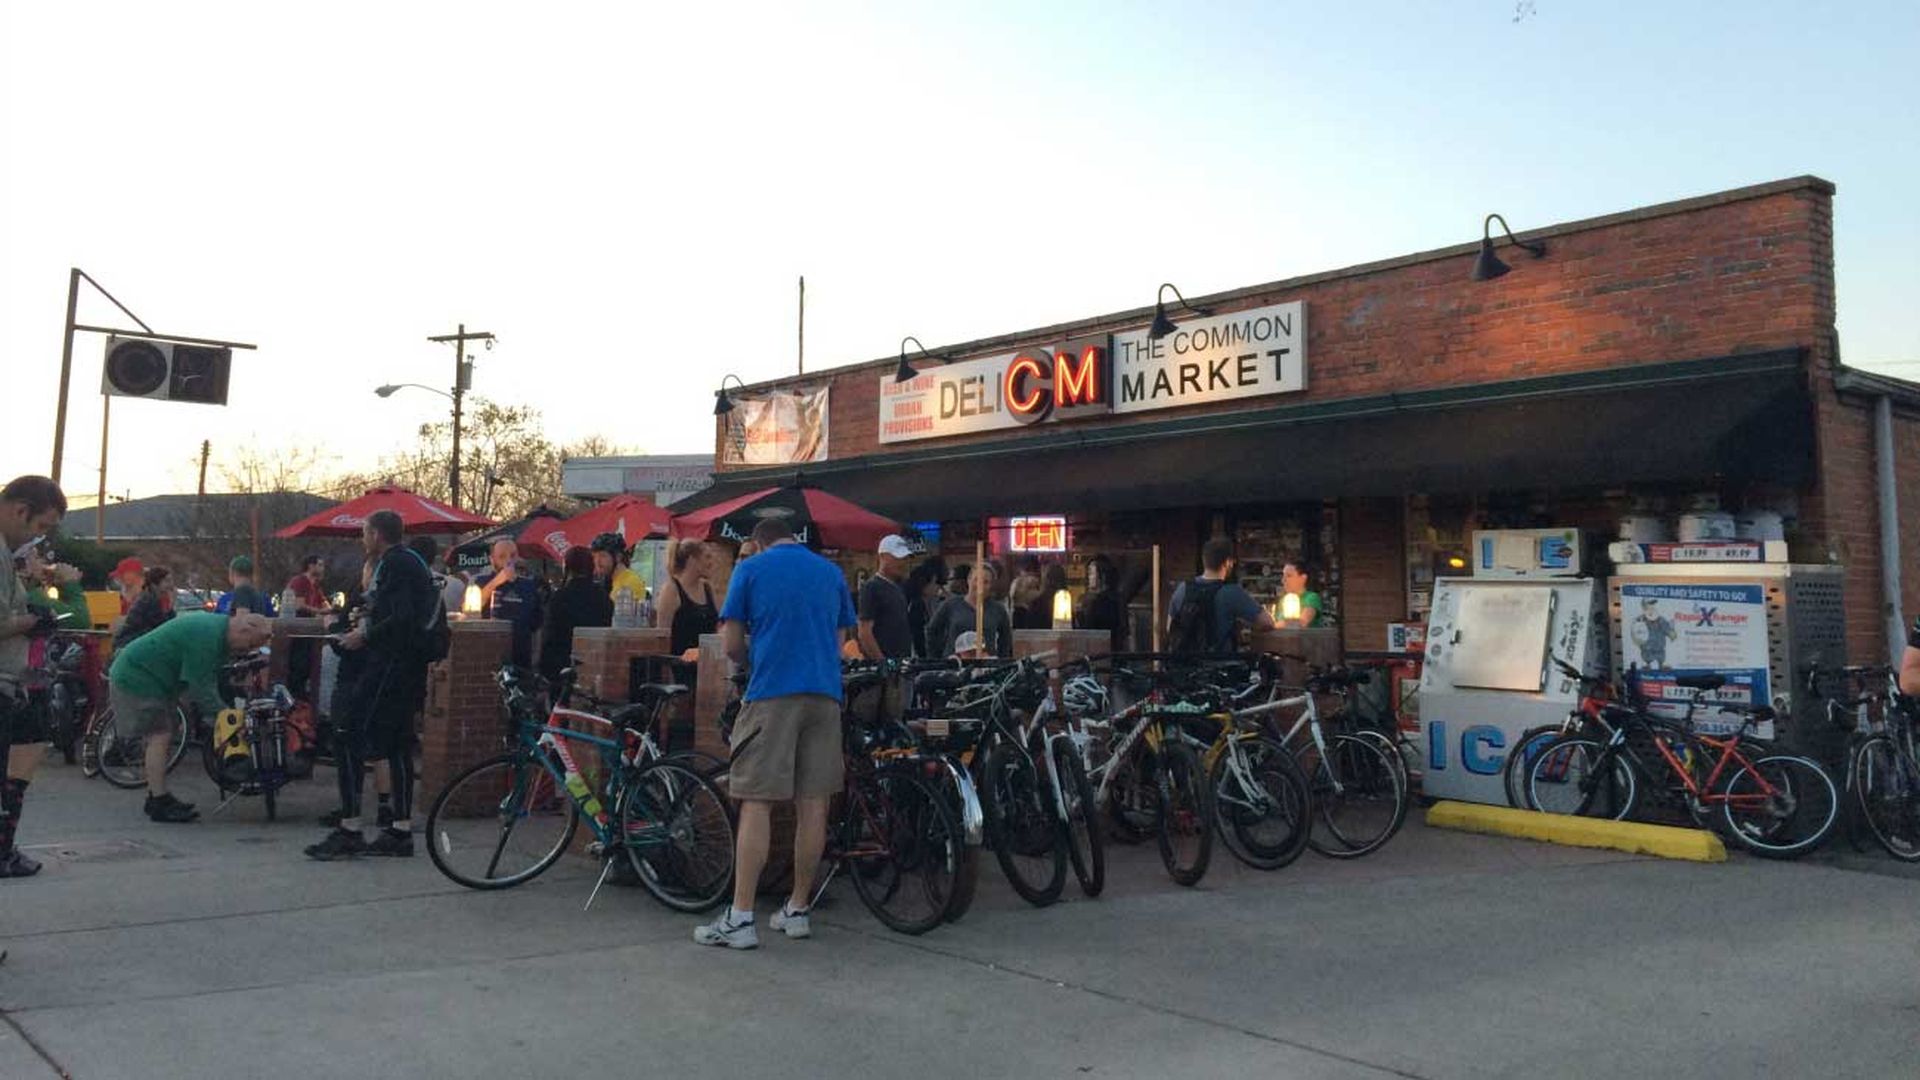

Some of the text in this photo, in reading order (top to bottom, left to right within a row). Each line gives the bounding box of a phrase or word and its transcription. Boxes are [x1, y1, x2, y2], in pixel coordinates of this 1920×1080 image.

[1121, 313, 1292, 364] THE COMMON
[940, 372, 1002, 420] DELI
[1121, 348, 1290, 403] MARKET
[1014, 520, 1063, 548] OPEN
[1481, 535, 1572, 569] IE
[1634, 586, 1669, 597] QUALITY
[1669, 588, 1687, 598] AND
[1688, 588, 1718, 599] SAFETY
[1719, 590, 1730, 600] TO
